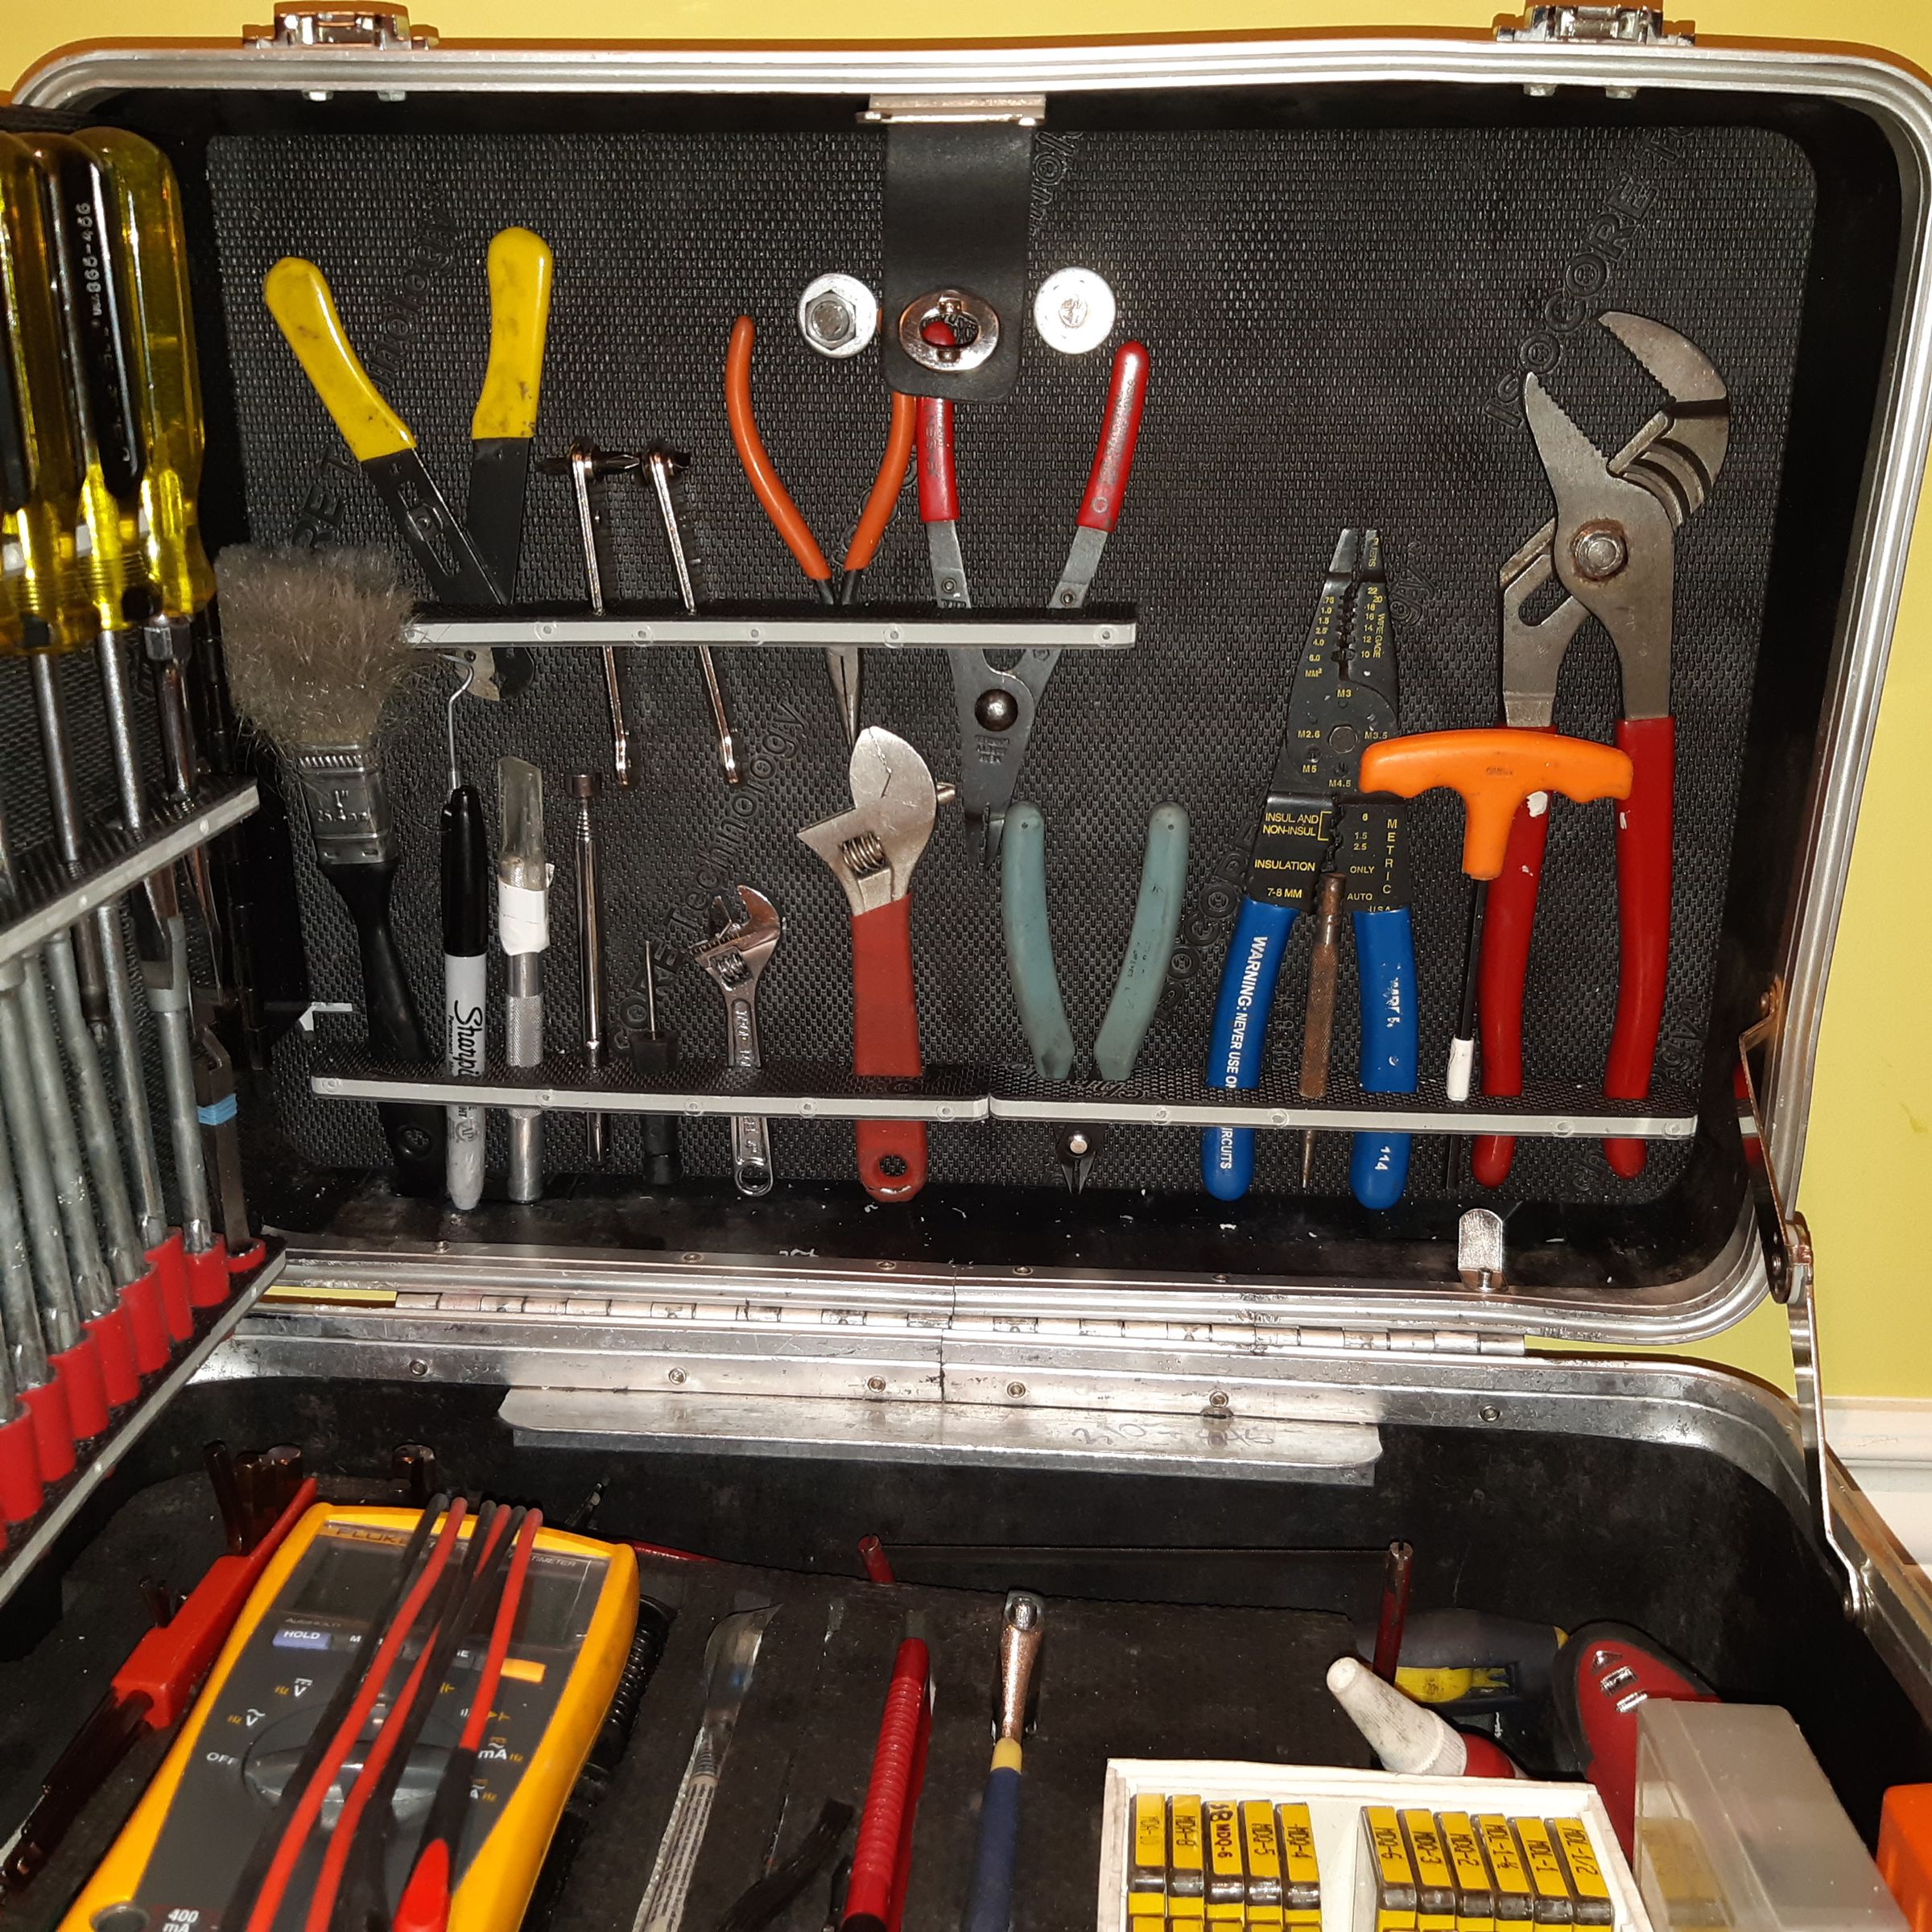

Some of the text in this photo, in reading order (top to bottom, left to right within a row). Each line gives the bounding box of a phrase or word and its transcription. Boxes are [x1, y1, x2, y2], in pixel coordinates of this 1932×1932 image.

[1337, 689, 1352, 697] M3
[1298, 730, 1320, 739] M2.6
[1364, 731, 1388, 739] M3.5
[1302, 765, 1317, 773] M5
[1328, 779, 1352, 787] M4.5
[1265, 812, 1319, 824] INSUL AND
[1262, 824, 1316, 836] NON-INSUL
[1354, 832, 1368, 840] 1.5
[1353, 843, 1367, 851] 2.5
[1382, 819, 1397, 894] METRIC
[1254, 859, 1315, 871] INSULATION
[1350, 865, 1375, 874] ONLY
[1267, 888, 1302, 898] 7-8 MM
[1347, 893, 1373, 901] AUTO
[1237, 935, 1269, 1010] WARNING:
[1228, 1012, 1249, 1049] NEVER
[452, 999, 484, 1076] Sharpi
[1227, 1051, 1241, 1075] USE
[1375, 1146, 1391, 1171] 114
[283, 1630, 321, 1640] HOLD
[207, 1752, 239, 1765] OFF
[477, 1748, 507, 1761] mA
[167, 1908, 200, 1923] 400
